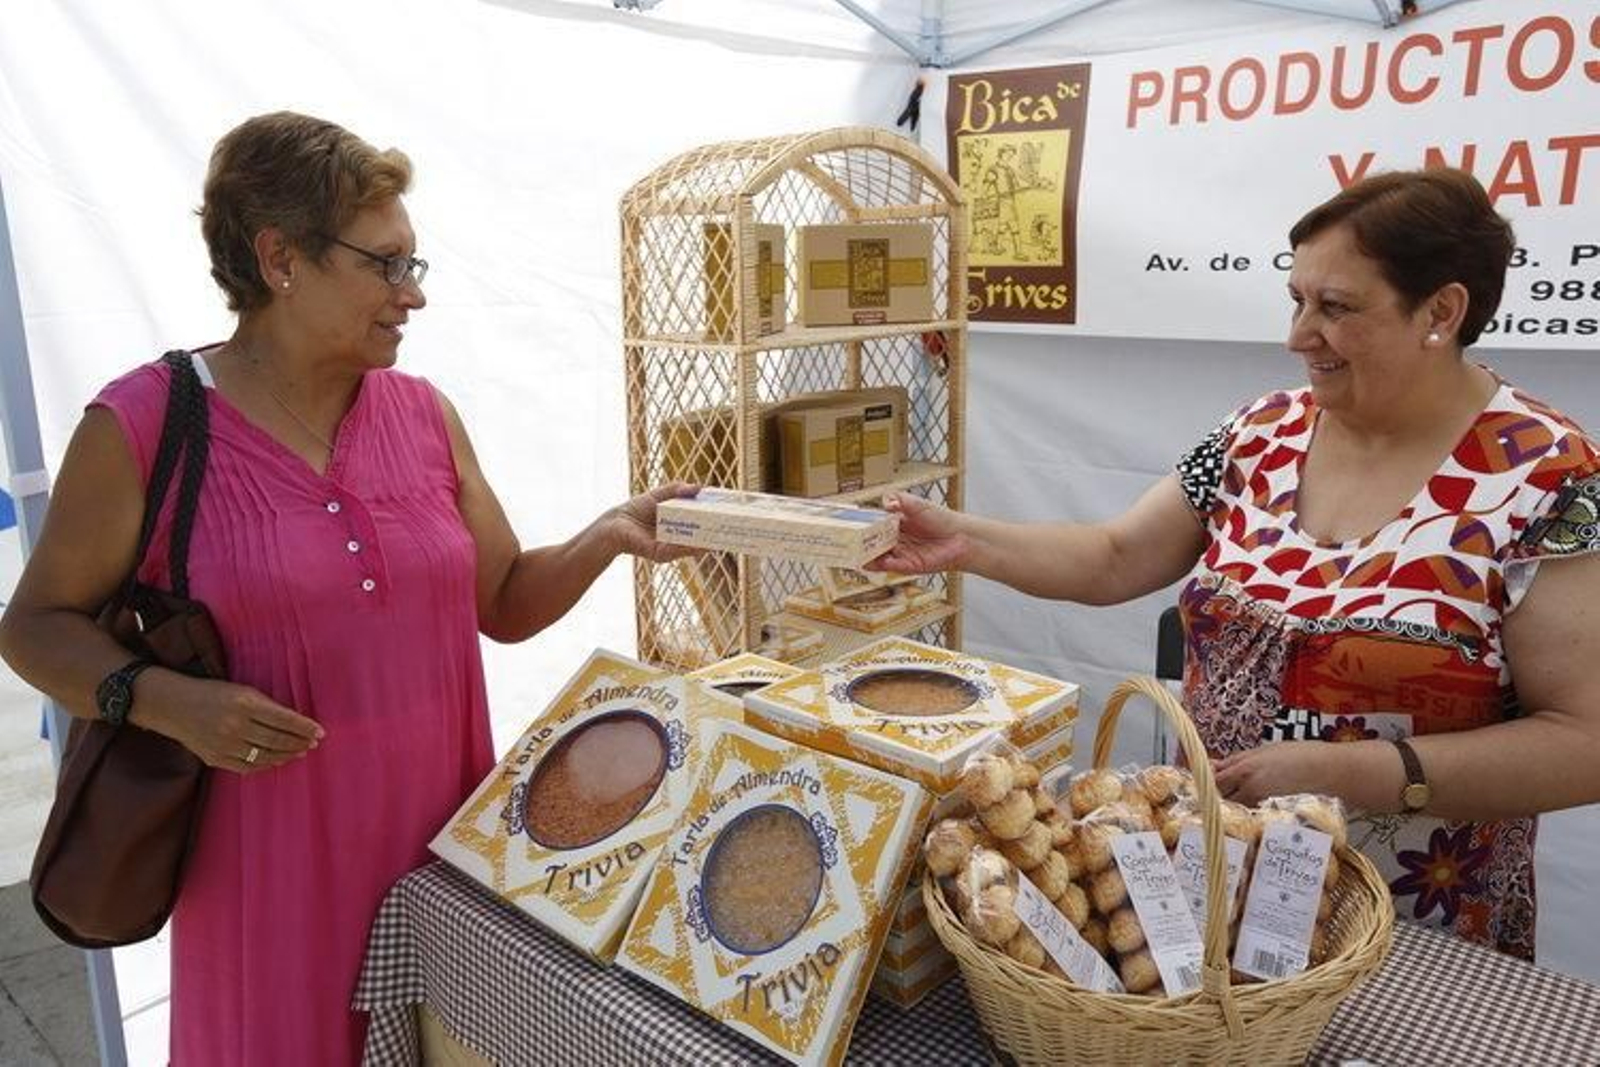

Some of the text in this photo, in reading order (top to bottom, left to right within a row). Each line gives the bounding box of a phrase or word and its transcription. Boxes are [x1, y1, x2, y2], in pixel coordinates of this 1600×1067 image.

[1126, 15, 1600, 129] PRODUCTO
[955, 79, 1082, 134] Bica de
[1146, 254, 1189, 272] Av.
[1210, 253, 1251, 271] de
[584, 684, 679, 711] Almendra
[874, 718, 988, 735] Trivia
[730, 767, 821, 797] Almendra
[544, 841, 647, 894] Trivia
[736, 942, 842, 1013] Trivia
